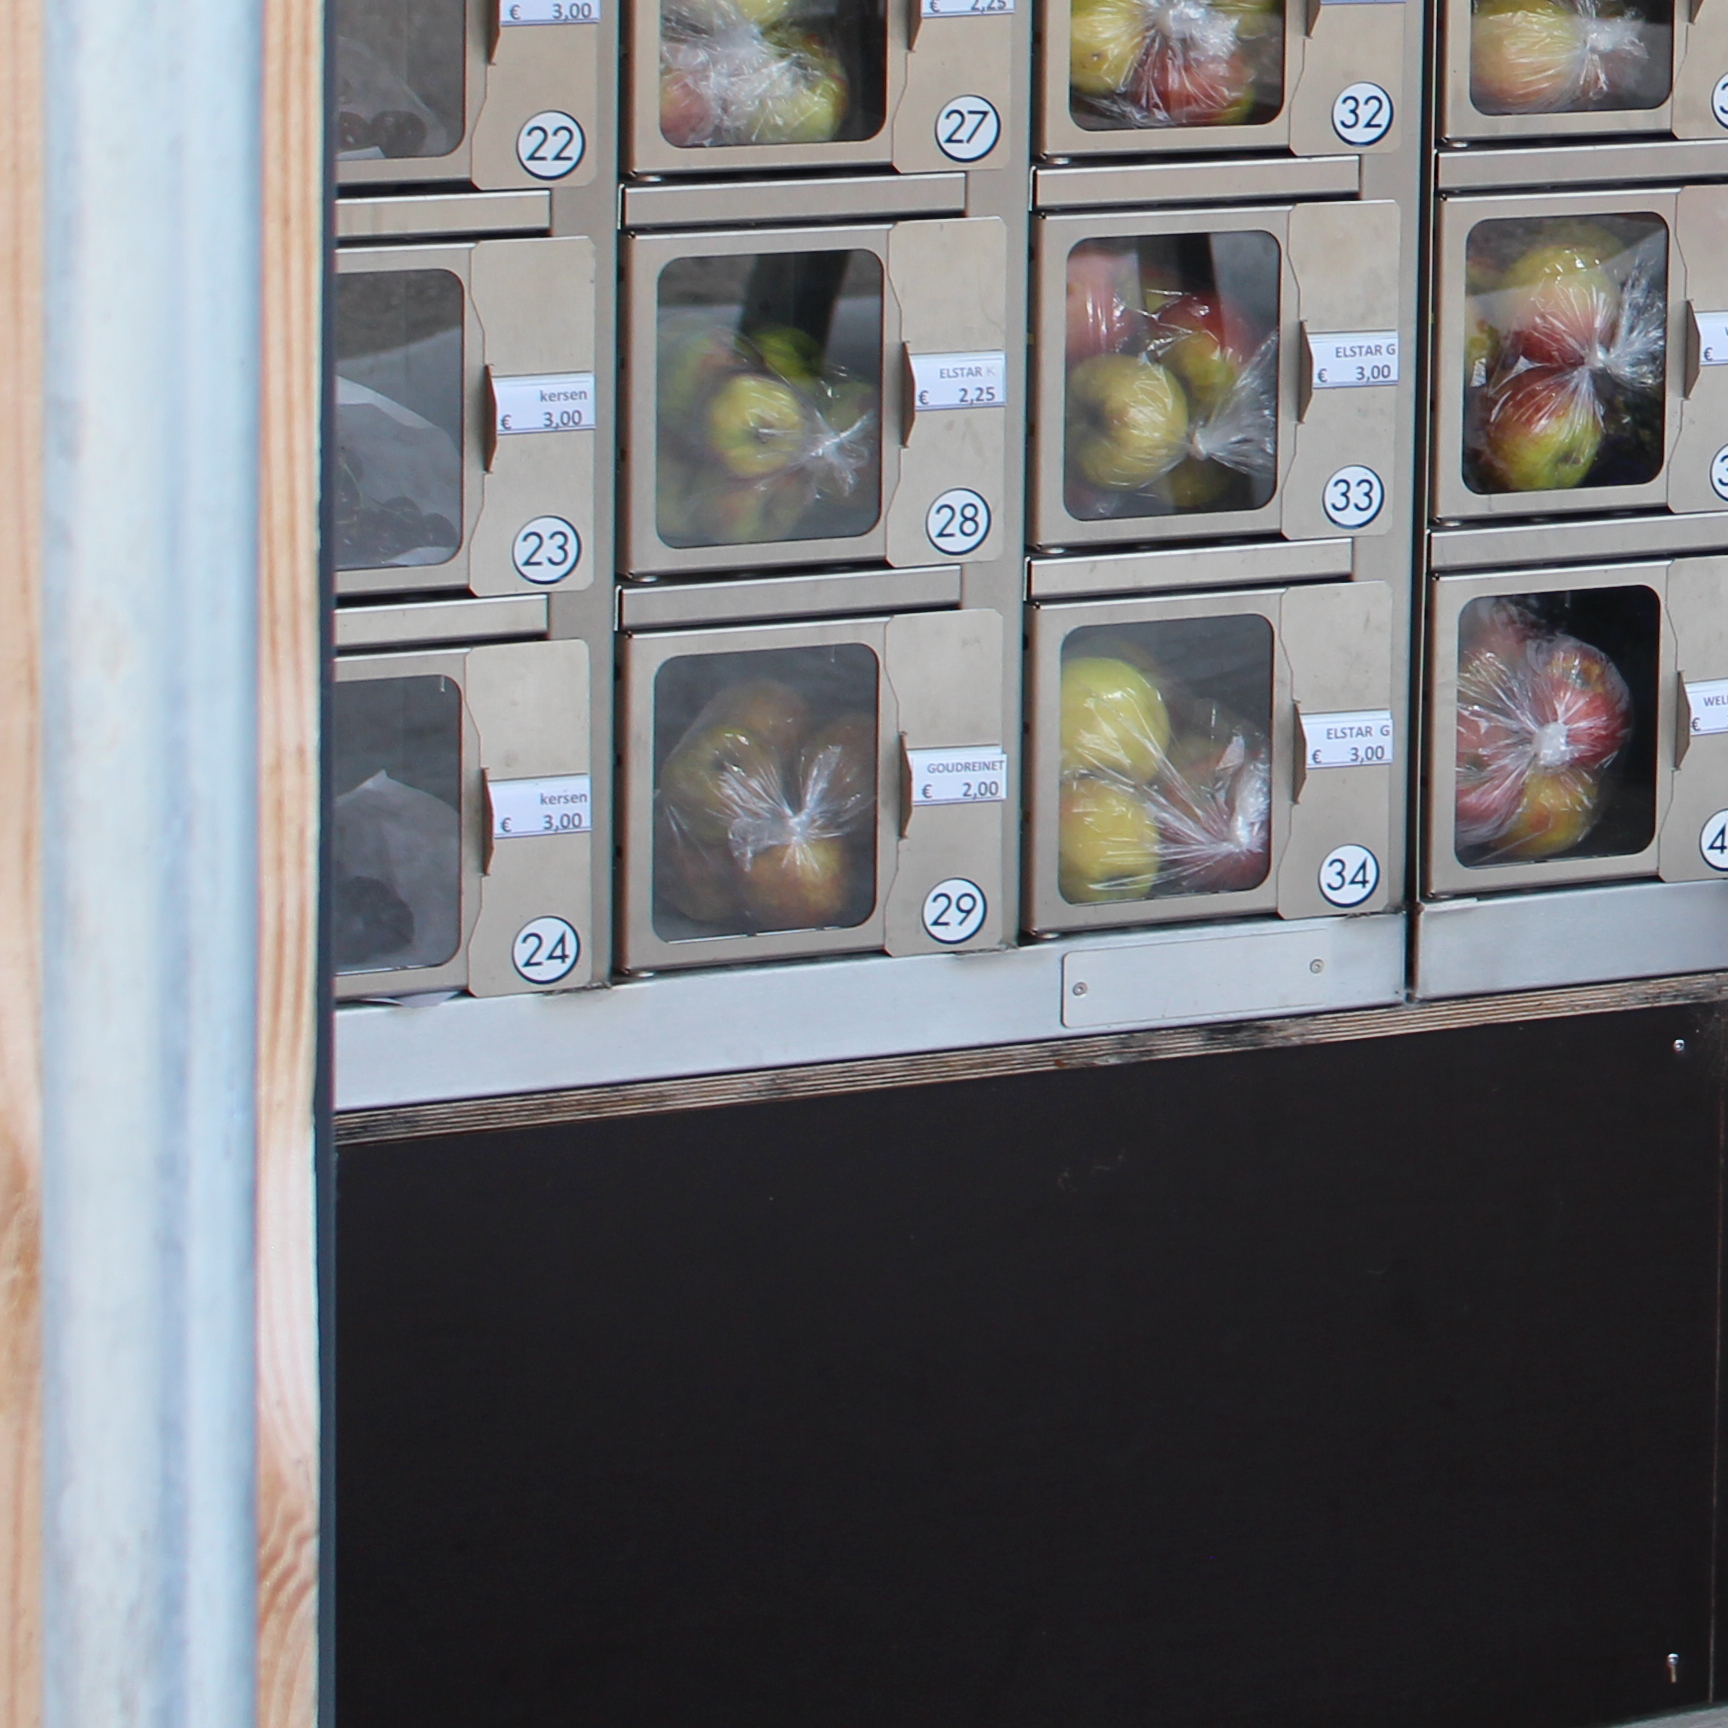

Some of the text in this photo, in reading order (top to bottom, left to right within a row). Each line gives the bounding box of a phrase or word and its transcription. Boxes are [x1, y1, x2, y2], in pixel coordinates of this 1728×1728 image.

[527, 126, 573, 161] 22
[1703, 347, 1713, 361] €
[936, 503, 979, 538] 28
[522, 531, 568, 566] 23
[927, 760, 1004, 773] GOUDREINET
[921, 782, 999, 799] € 2,00
[1327, 859, 1369, 891] 34
